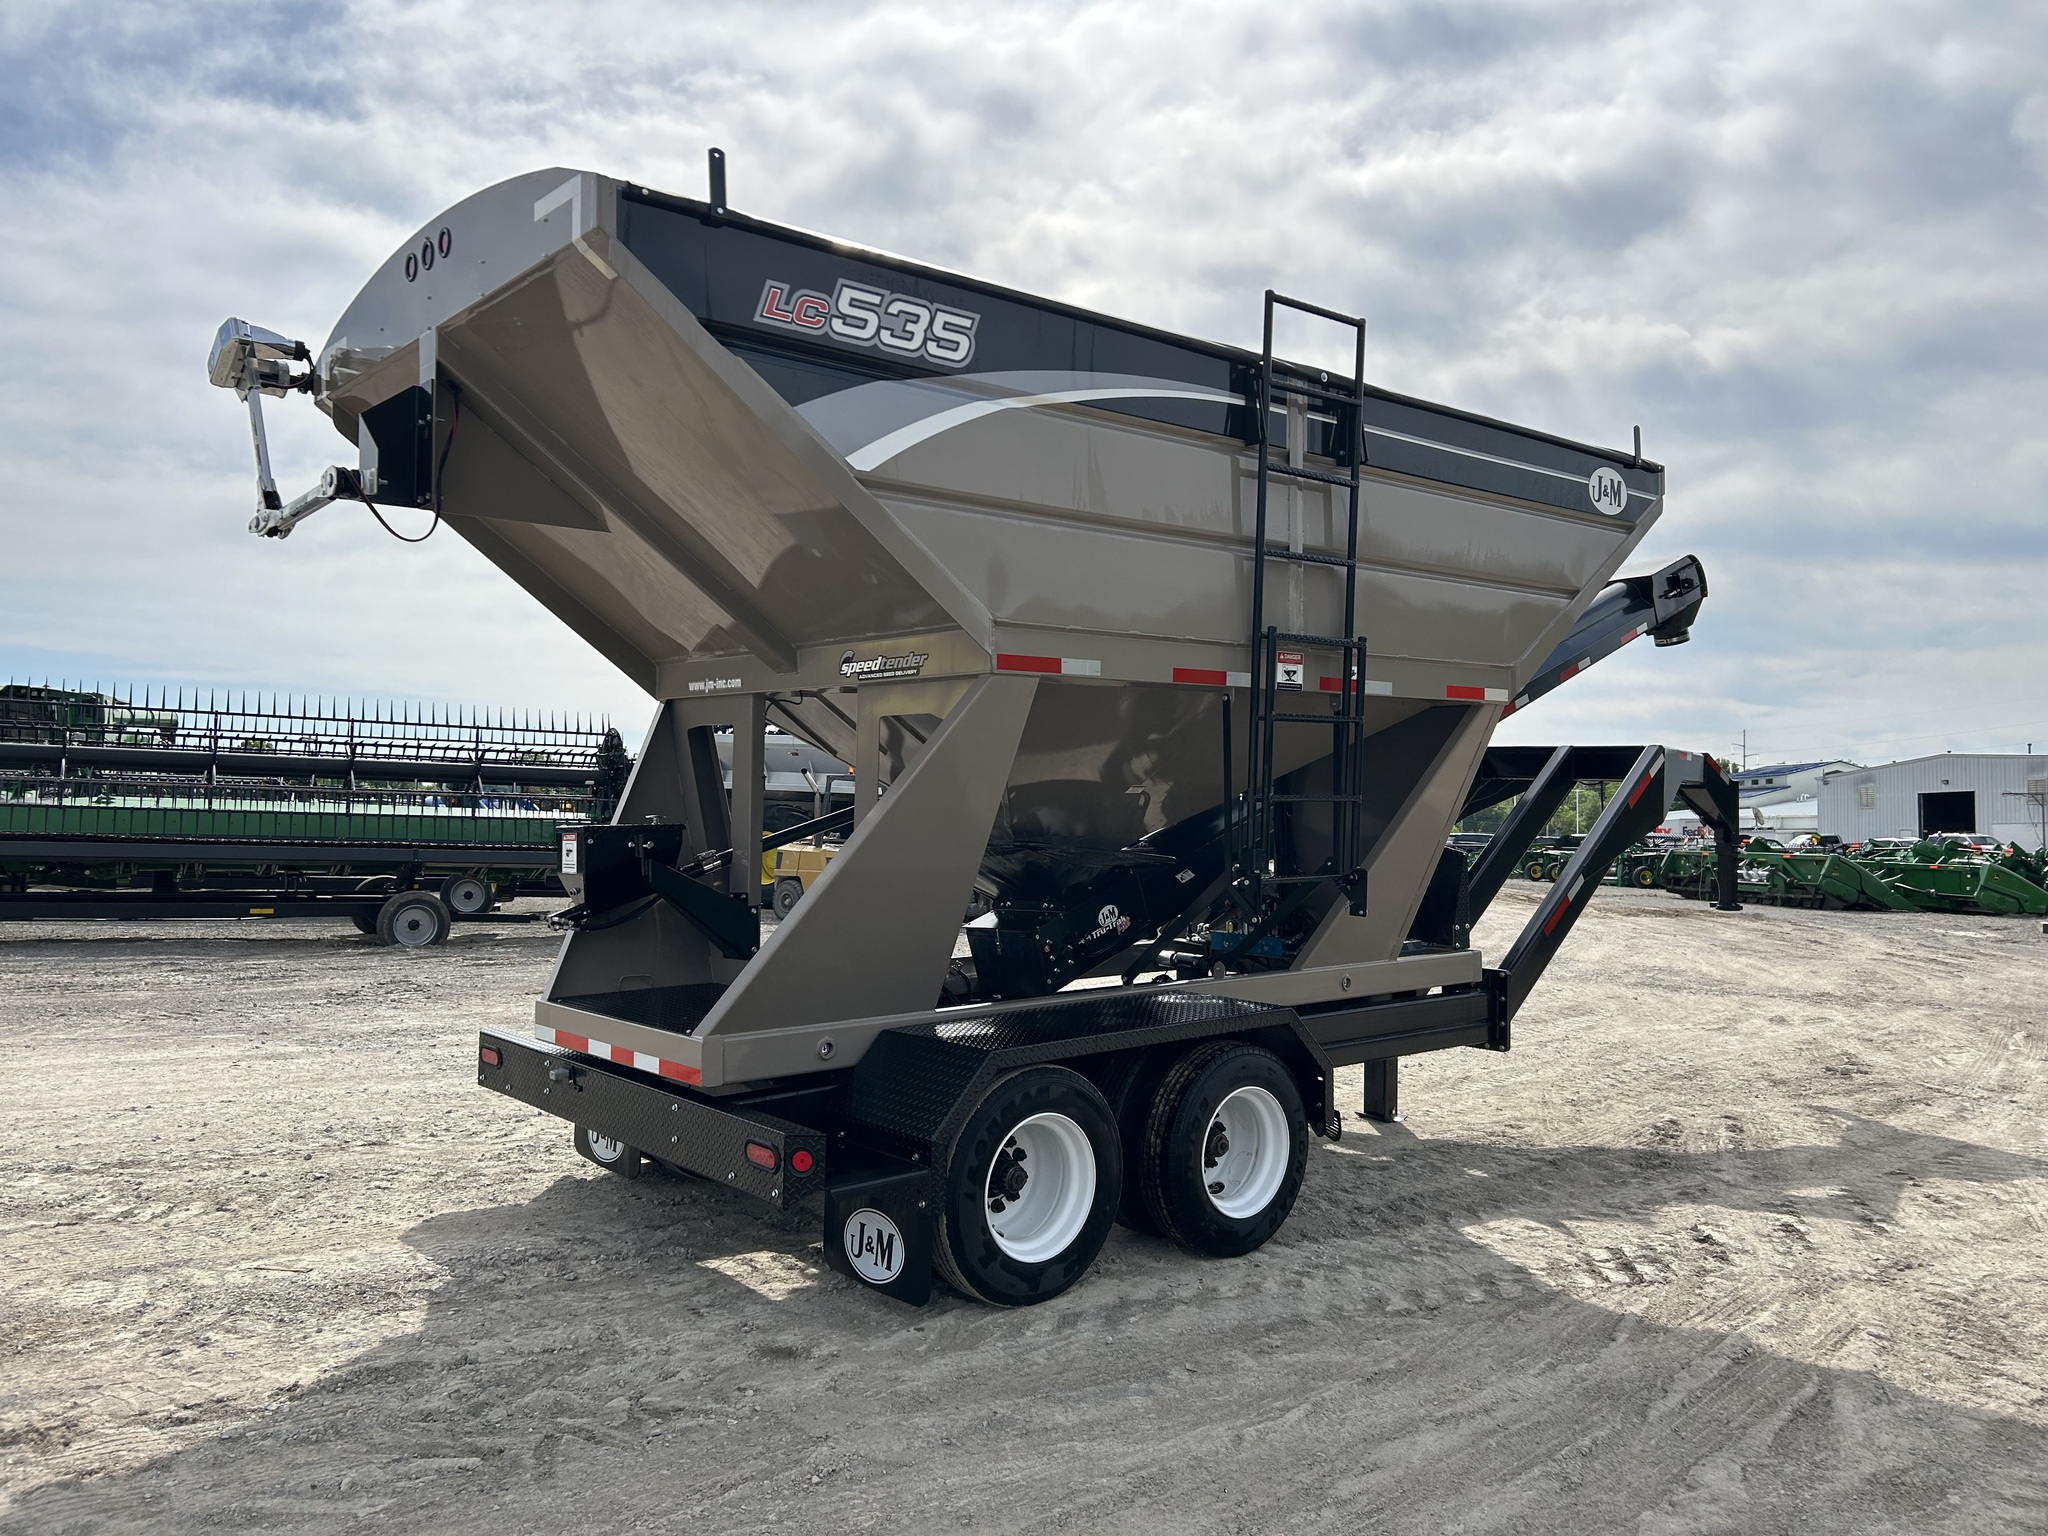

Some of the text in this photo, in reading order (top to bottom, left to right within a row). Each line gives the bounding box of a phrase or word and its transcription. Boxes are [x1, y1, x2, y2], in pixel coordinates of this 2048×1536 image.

[1592, 475, 1622, 508] J&M
[688, 678, 742, 693] www.jm-inc.com
[859, 672, 883, 680] ADVANCED
[1100, 906, 1117, 925] J&M
[1268, 1106, 1307, 1229] IRONMAN
[850, 1221, 896, 1273] J&M
